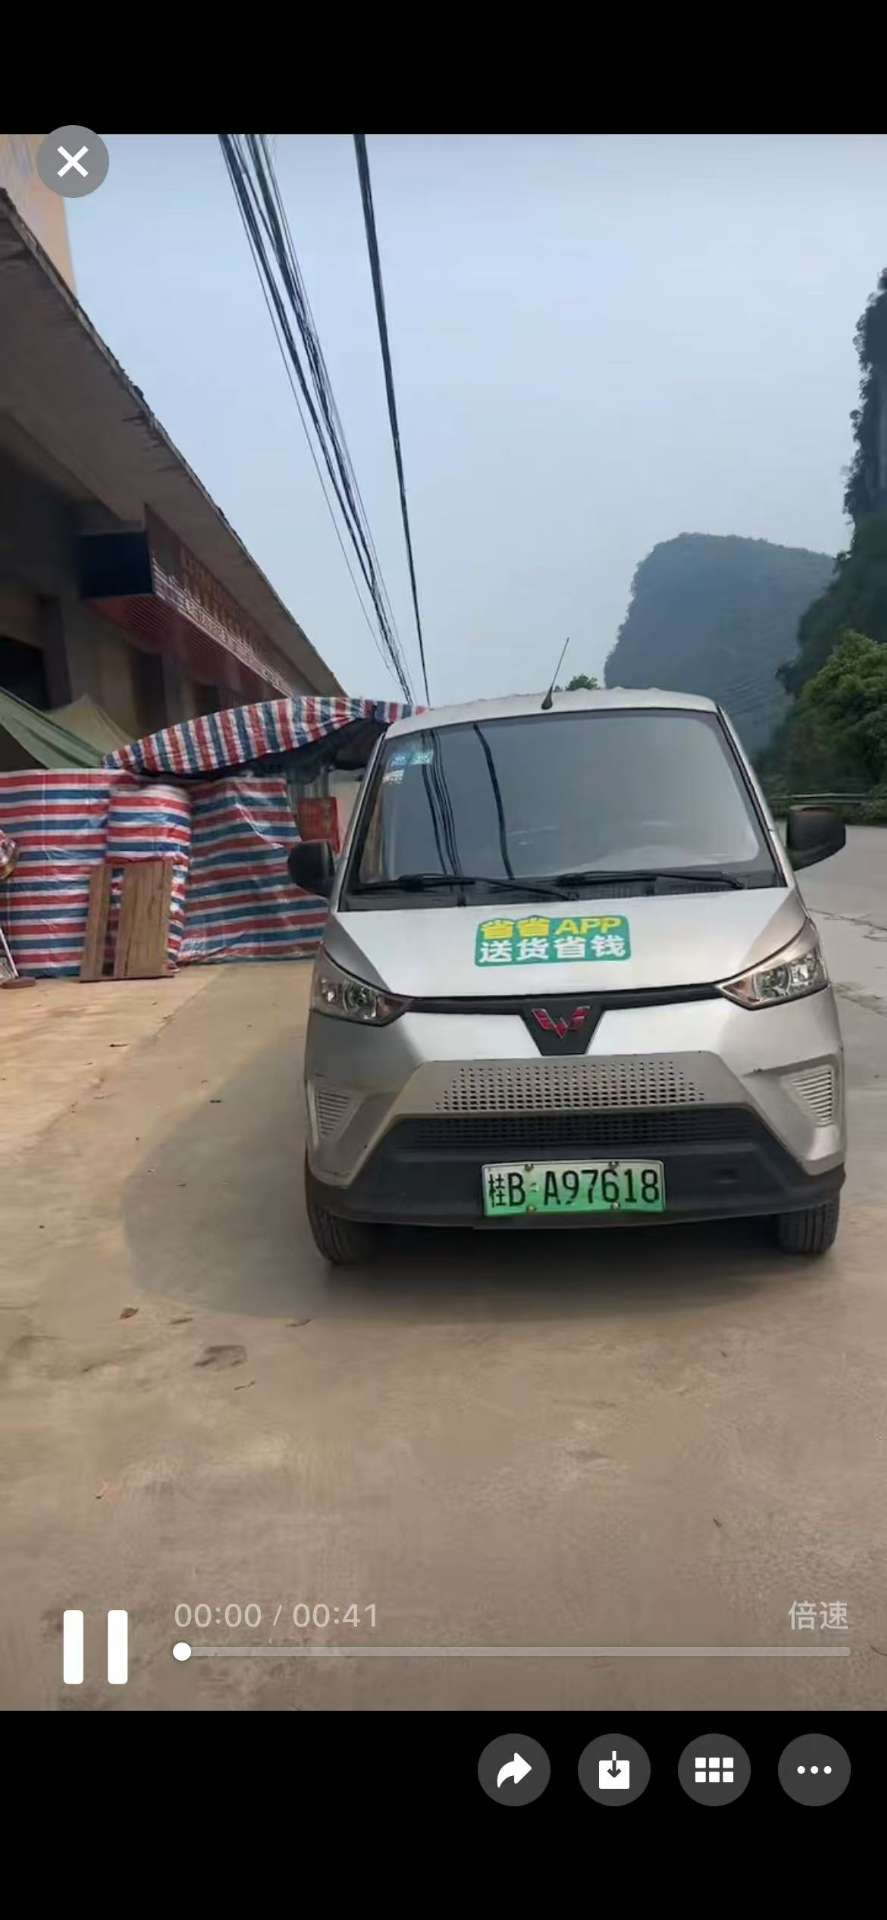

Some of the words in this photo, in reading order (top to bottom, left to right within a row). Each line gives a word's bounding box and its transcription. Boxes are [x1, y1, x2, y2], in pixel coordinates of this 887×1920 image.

[480, 917, 550, 940] 省省
[555, 917, 623, 935] APP
[479, 934, 626, 963] 送货省钱
